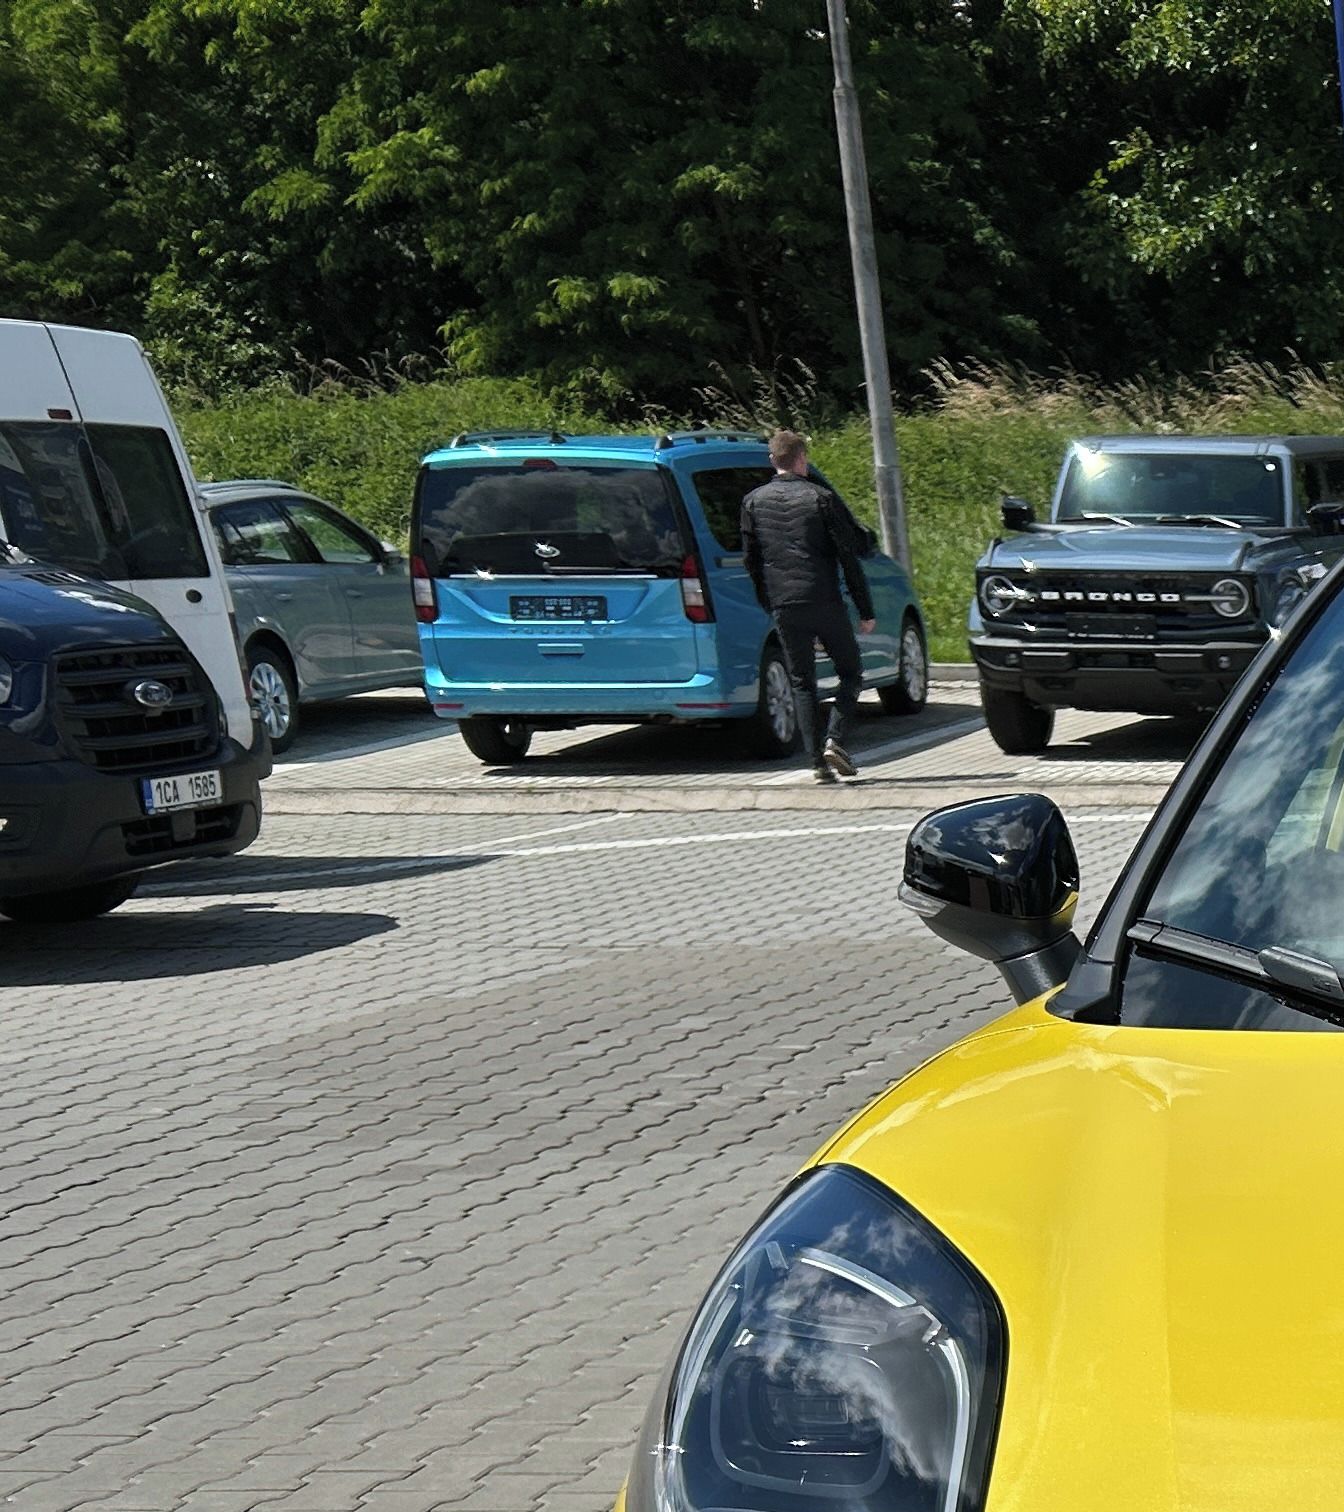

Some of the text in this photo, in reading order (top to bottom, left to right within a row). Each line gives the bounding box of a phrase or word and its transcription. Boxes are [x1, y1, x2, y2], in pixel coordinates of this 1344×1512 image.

[1040, 591, 1181, 602] BRONCO
[155, 774, 217, 805] 1CA 1585
